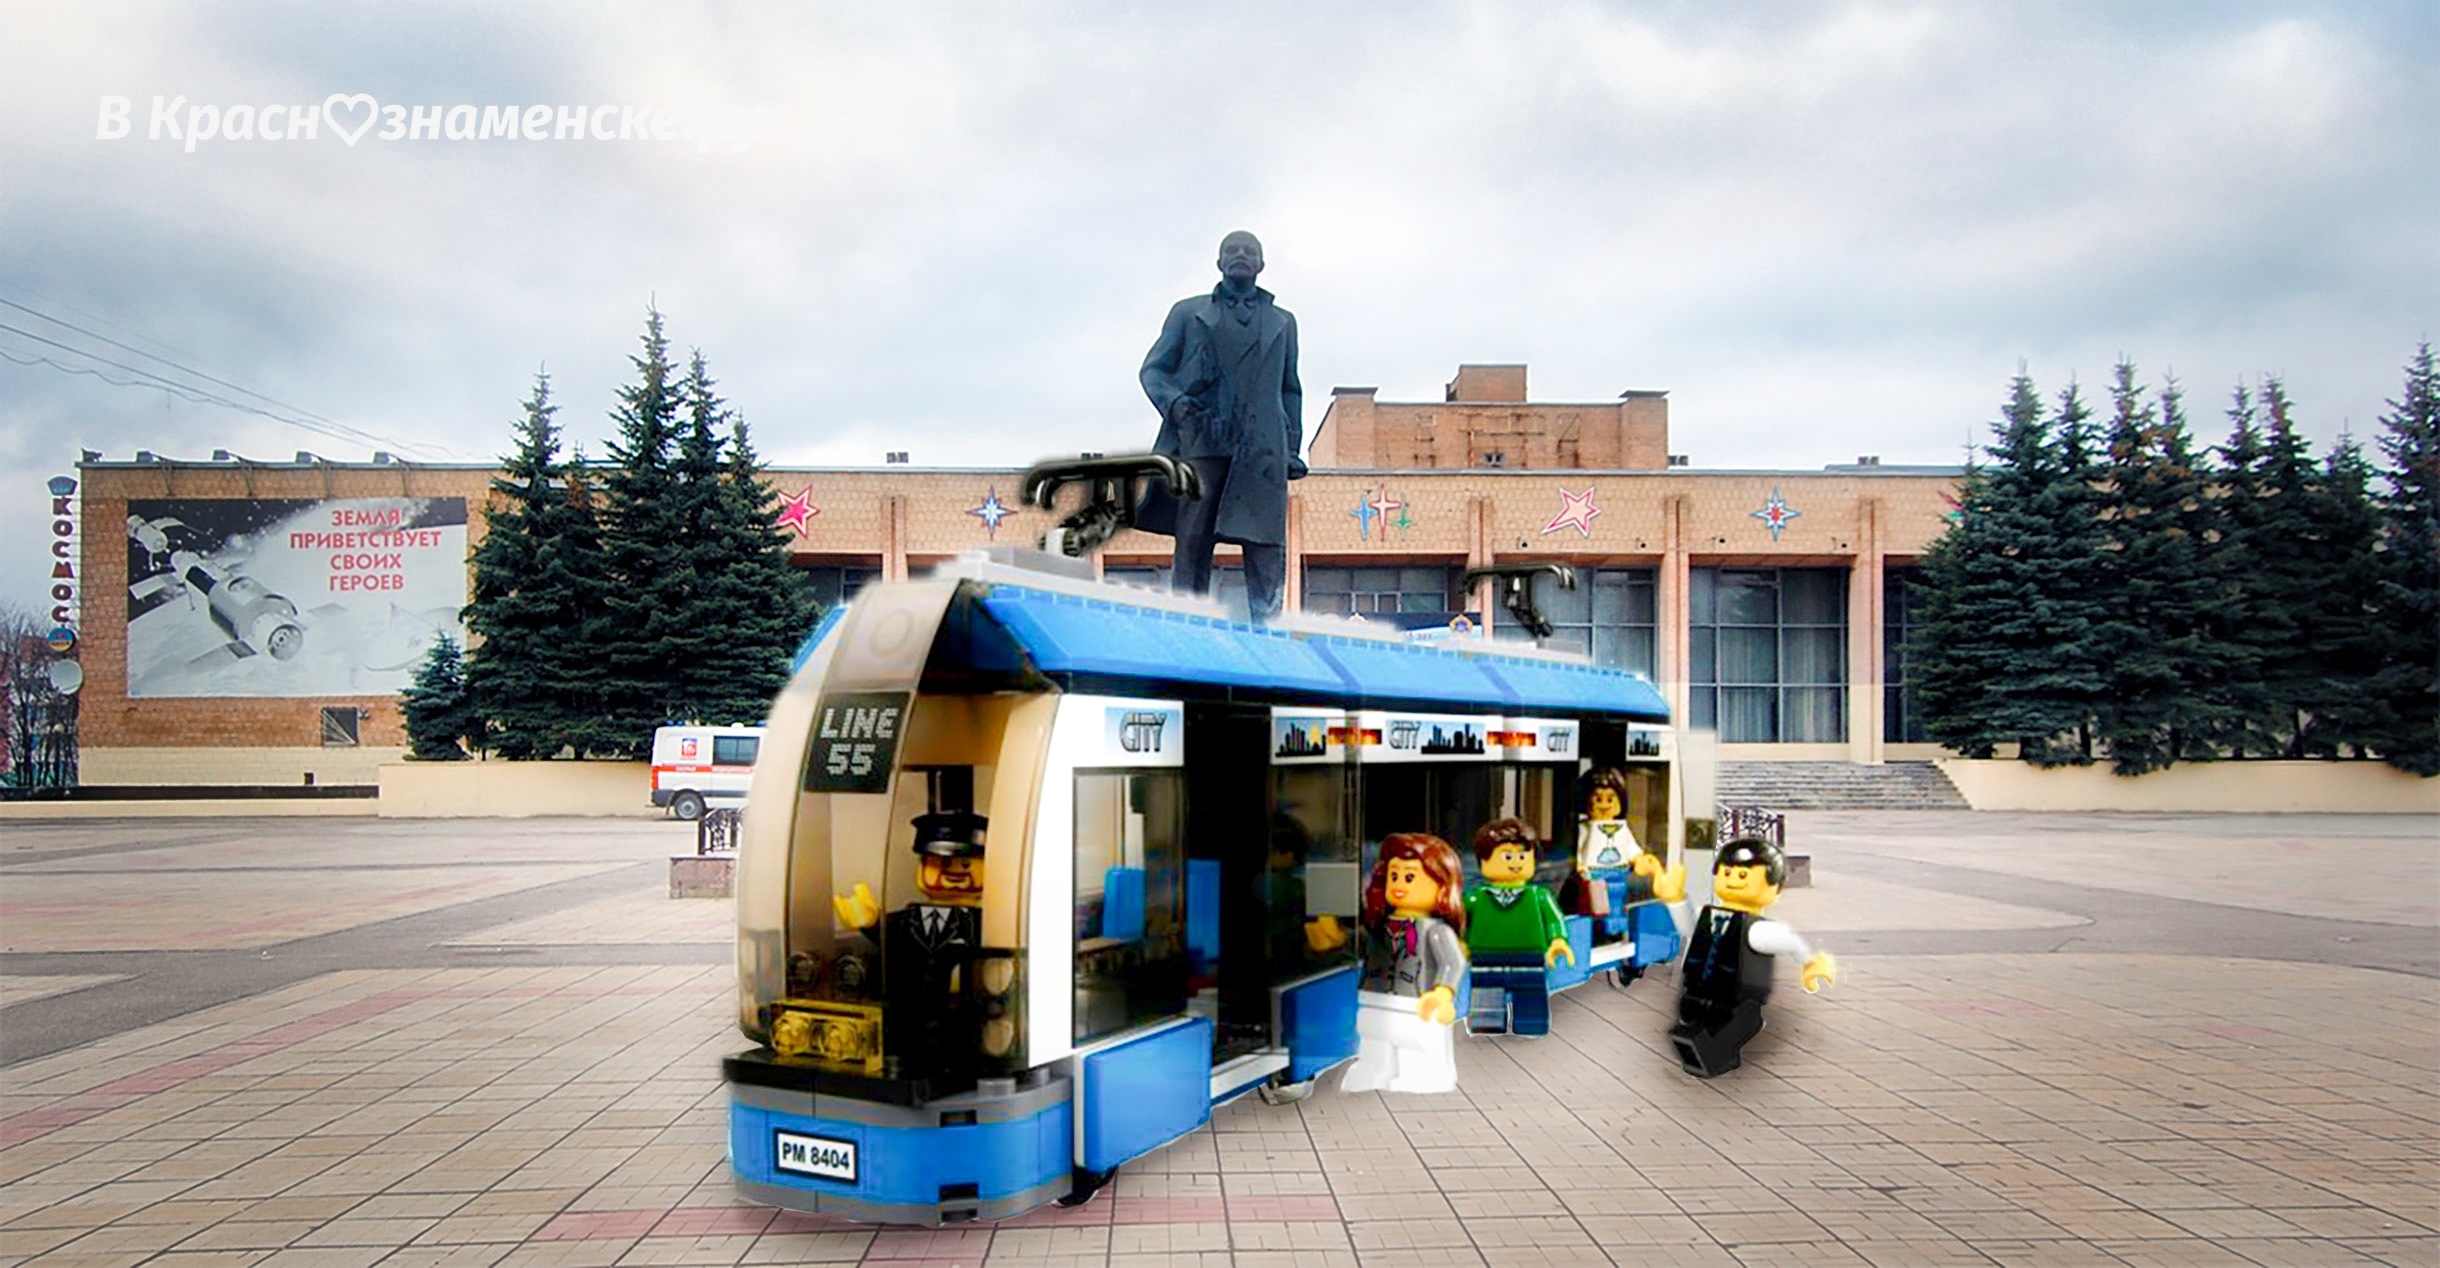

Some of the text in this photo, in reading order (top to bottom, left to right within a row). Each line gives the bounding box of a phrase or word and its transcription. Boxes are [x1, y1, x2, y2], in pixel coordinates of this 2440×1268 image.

[331, 509, 401, 526] ЗЕМЛЯ
[290, 531, 441, 549] ПРИВЕТСТВУЕТ
[51, 496, 74, 623] КОСМОС
[330, 553, 401, 570] СВОИХ
[329, 574, 404, 592] ГЕРОЕВ
[820, 708, 899, 738] LINE
[1119, 712, 1168, 752] CITY
[1389, 720, 1421, 749] CITY
[826, 743, 876, 775] 55
[782, 1142, 850, 1170] PM 8404
